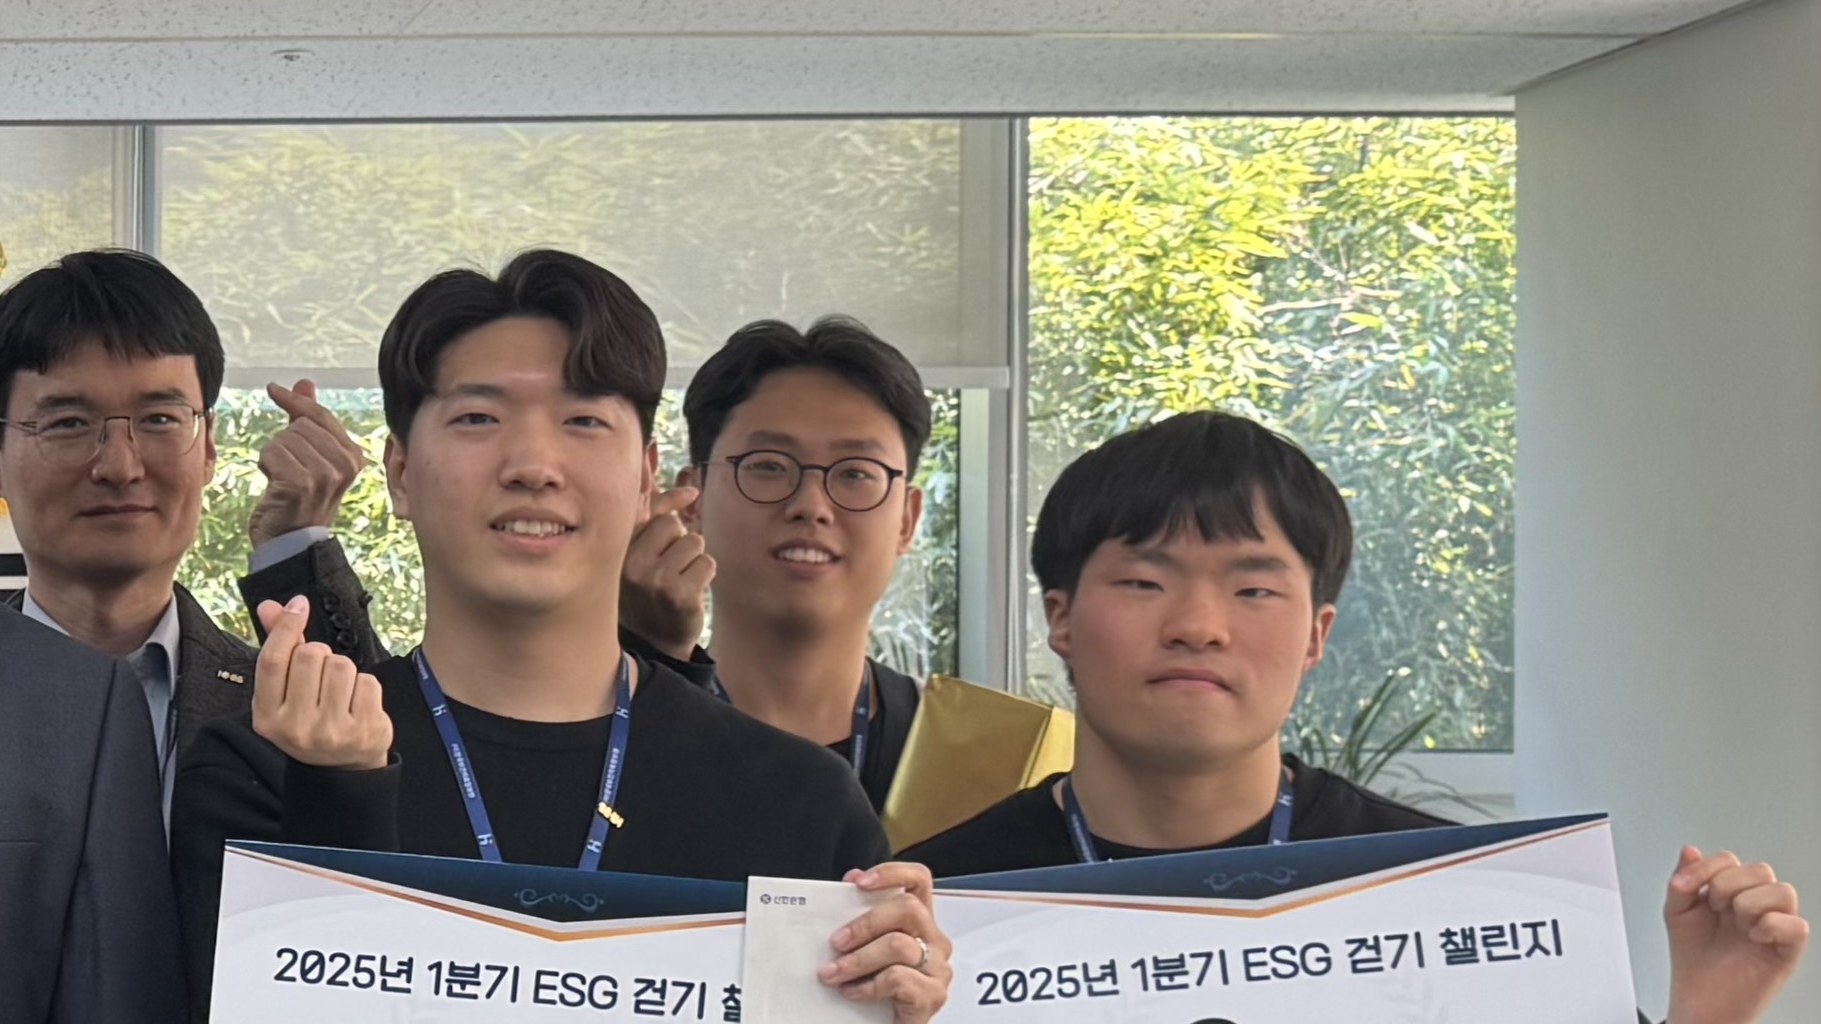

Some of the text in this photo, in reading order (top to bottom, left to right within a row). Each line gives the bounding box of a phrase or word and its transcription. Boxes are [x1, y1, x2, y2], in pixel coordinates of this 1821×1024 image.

[274, 947, 414, 994] 2025년
[427, 960, 520, 1004] 1분기
[532, 969, 619, 1011] ESG
[632, 978, 707, 1021] 걷기
[976, 918, 1563, 1007] 2025년 1분기 ESG 걷기 챌린지
